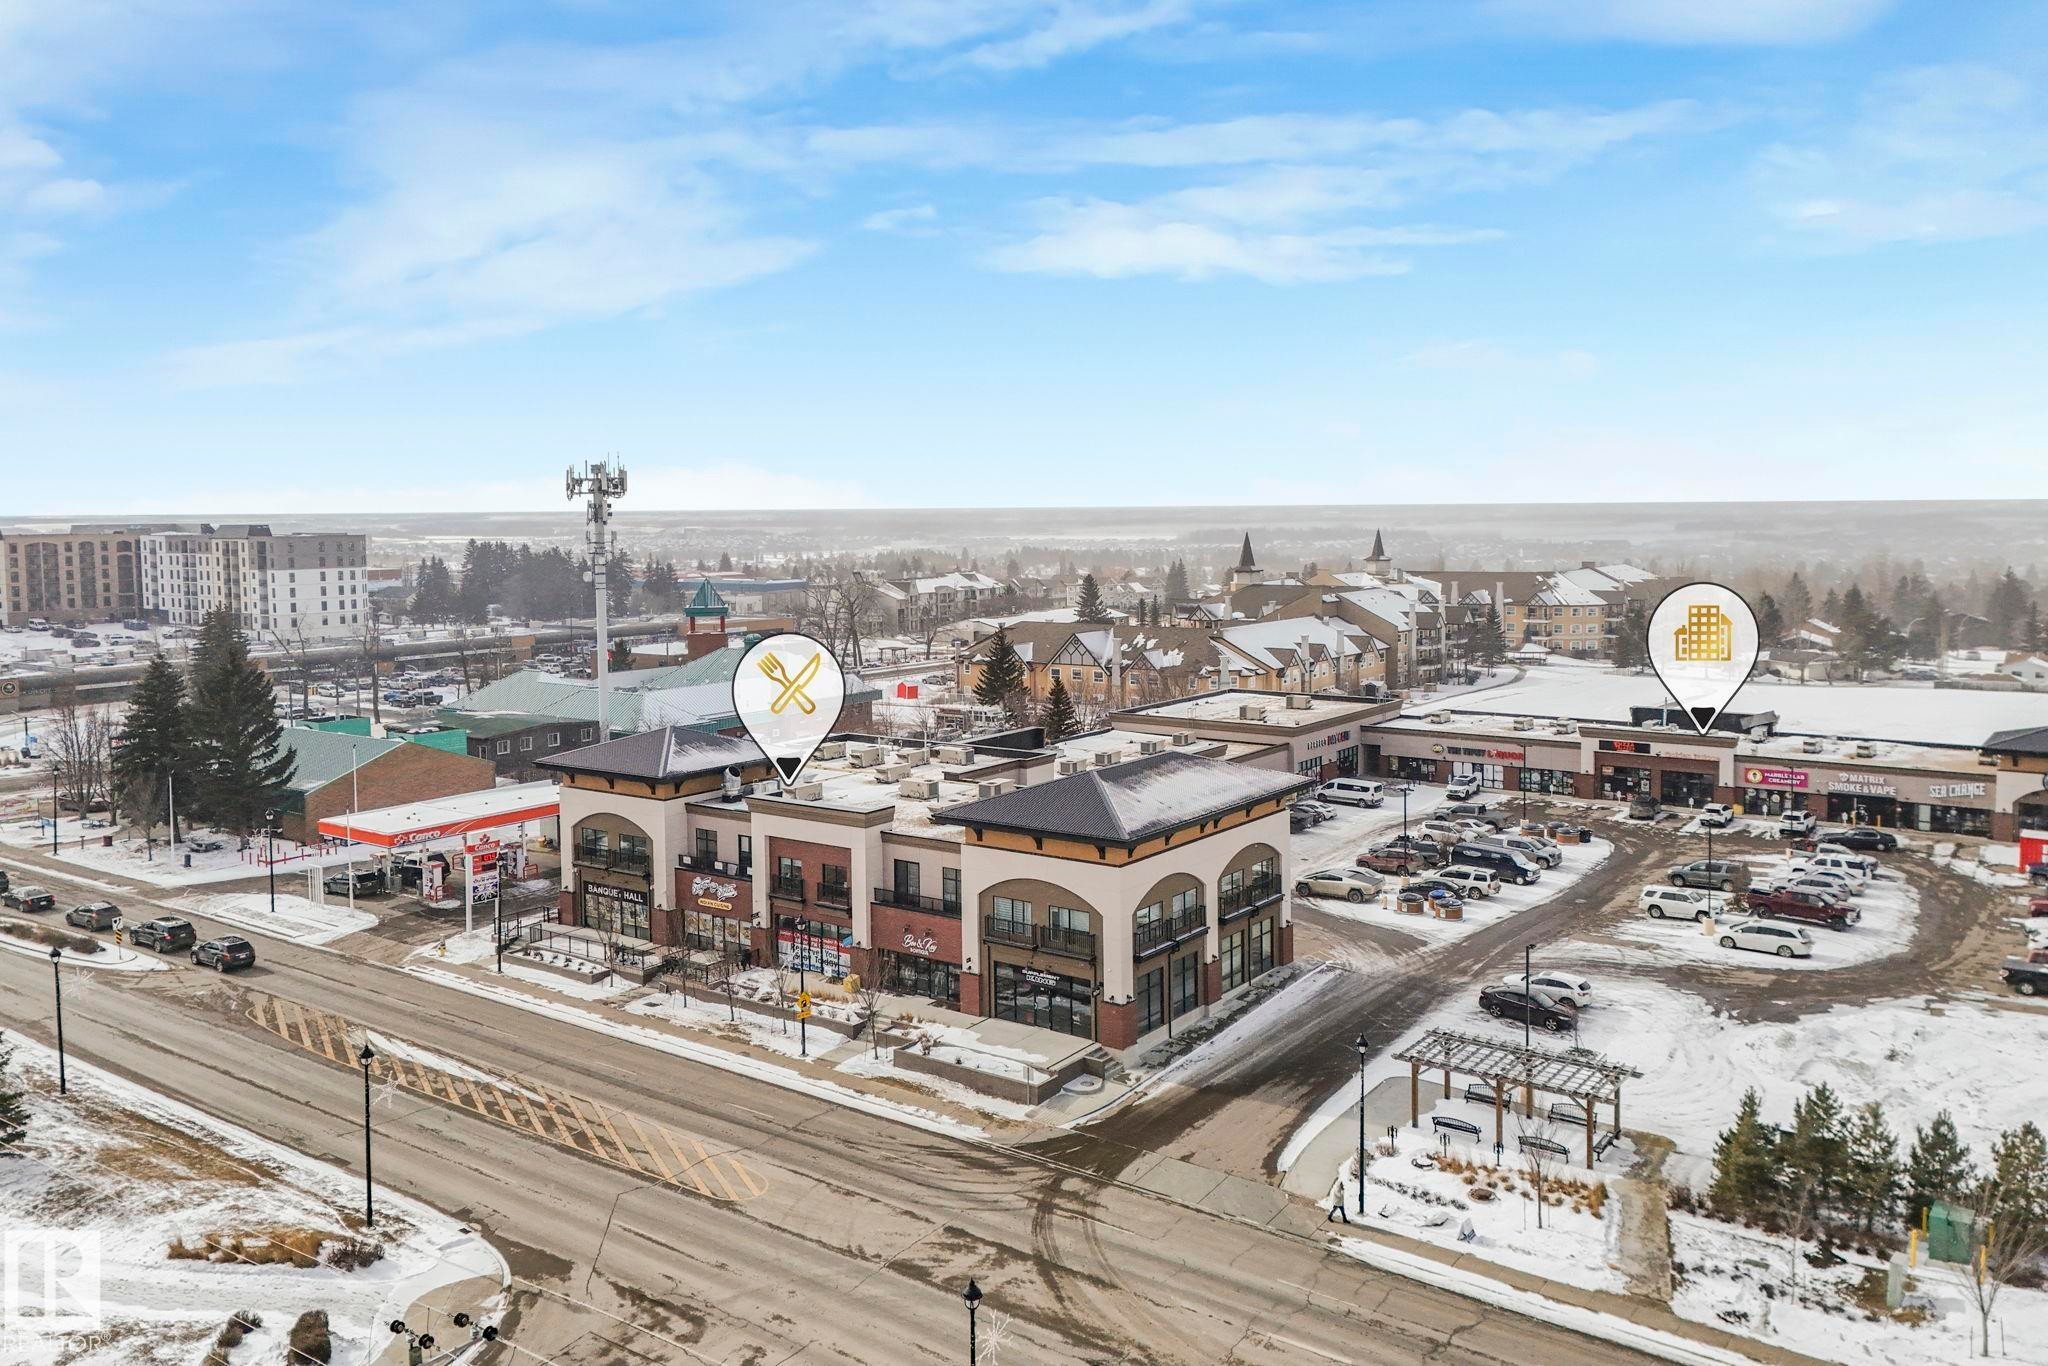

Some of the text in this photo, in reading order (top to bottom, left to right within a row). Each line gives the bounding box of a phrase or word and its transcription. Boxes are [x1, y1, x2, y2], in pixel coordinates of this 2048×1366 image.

[1849, 773, 1886, 785] MATRIX
[1828, 781, 1897, 796] SMOKE & VAPE
[1929, 783, 1987, 799] SEA CHANGE
[623, 892, 644, 903] HALL
